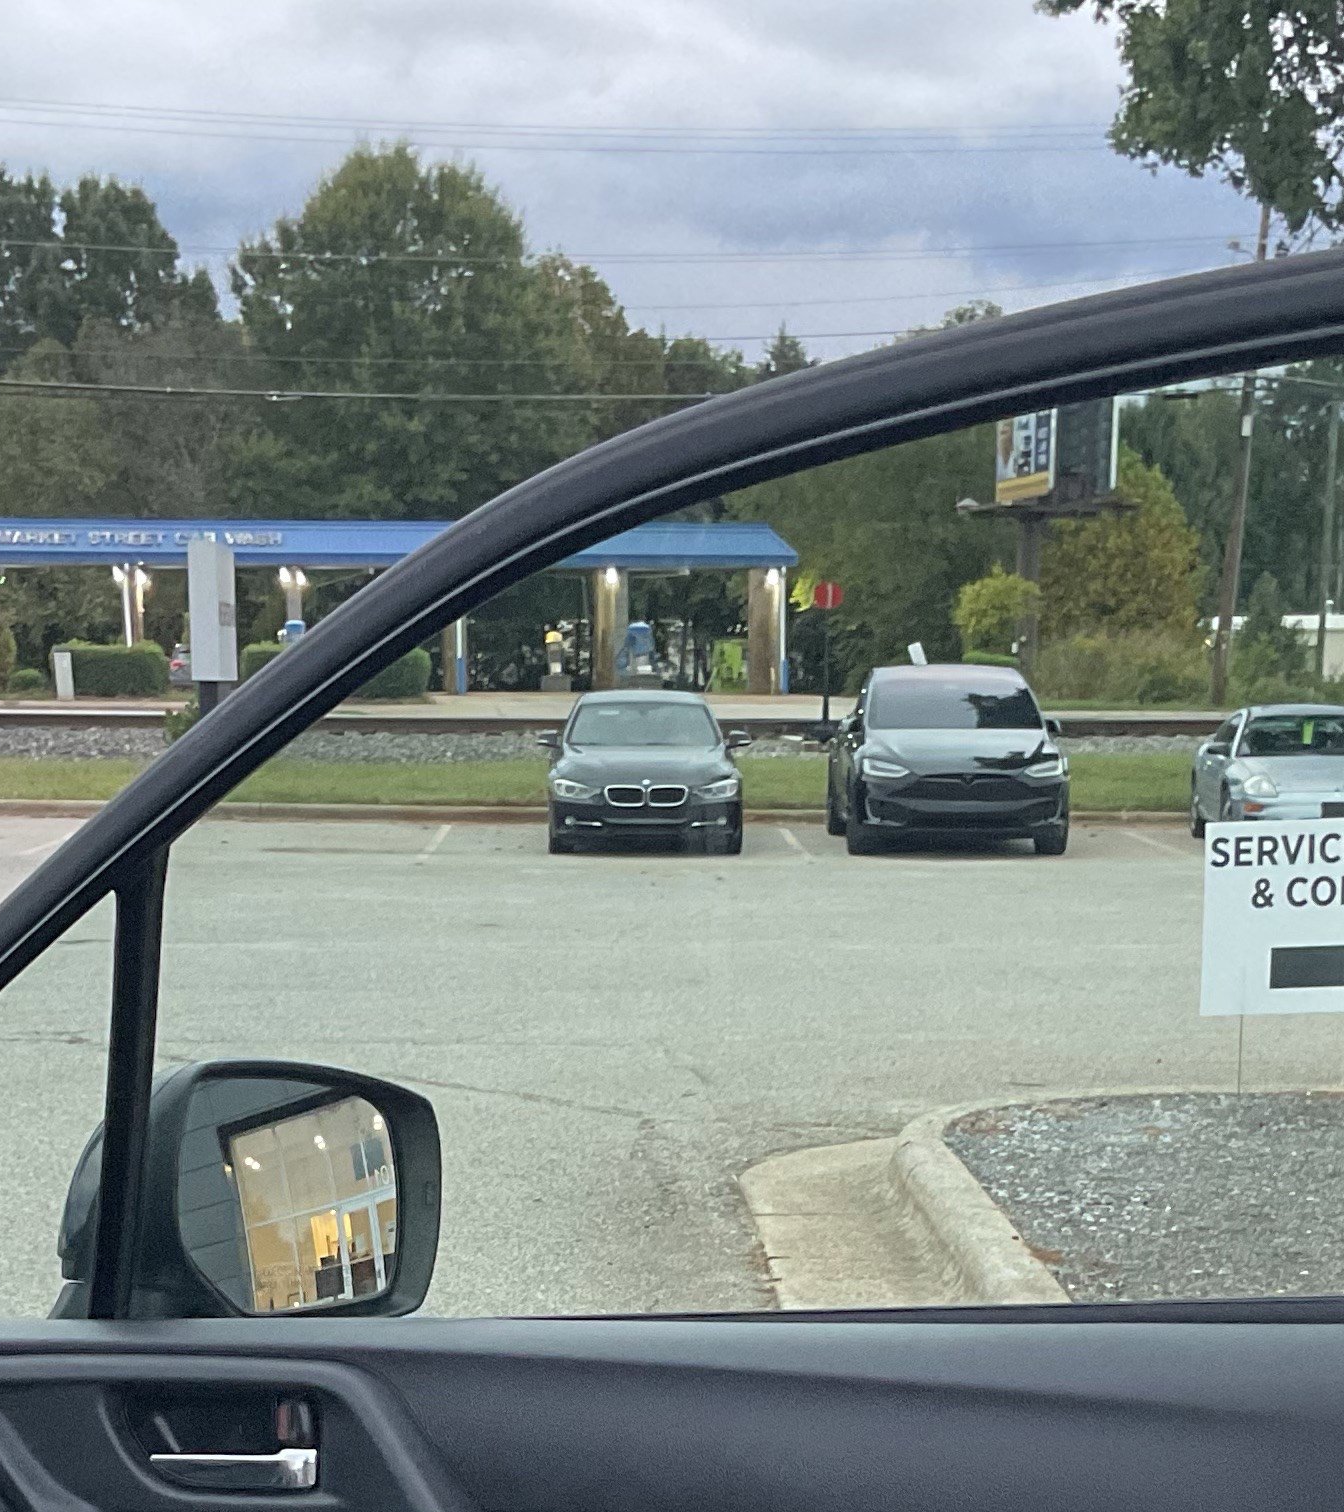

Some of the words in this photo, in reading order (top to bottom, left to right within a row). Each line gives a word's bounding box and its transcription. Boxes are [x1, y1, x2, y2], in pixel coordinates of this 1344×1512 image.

[88, 531, 167, 546] STREET
[224, 532, 283, 546] WASH
[1251, 877, 1274, 909] &
